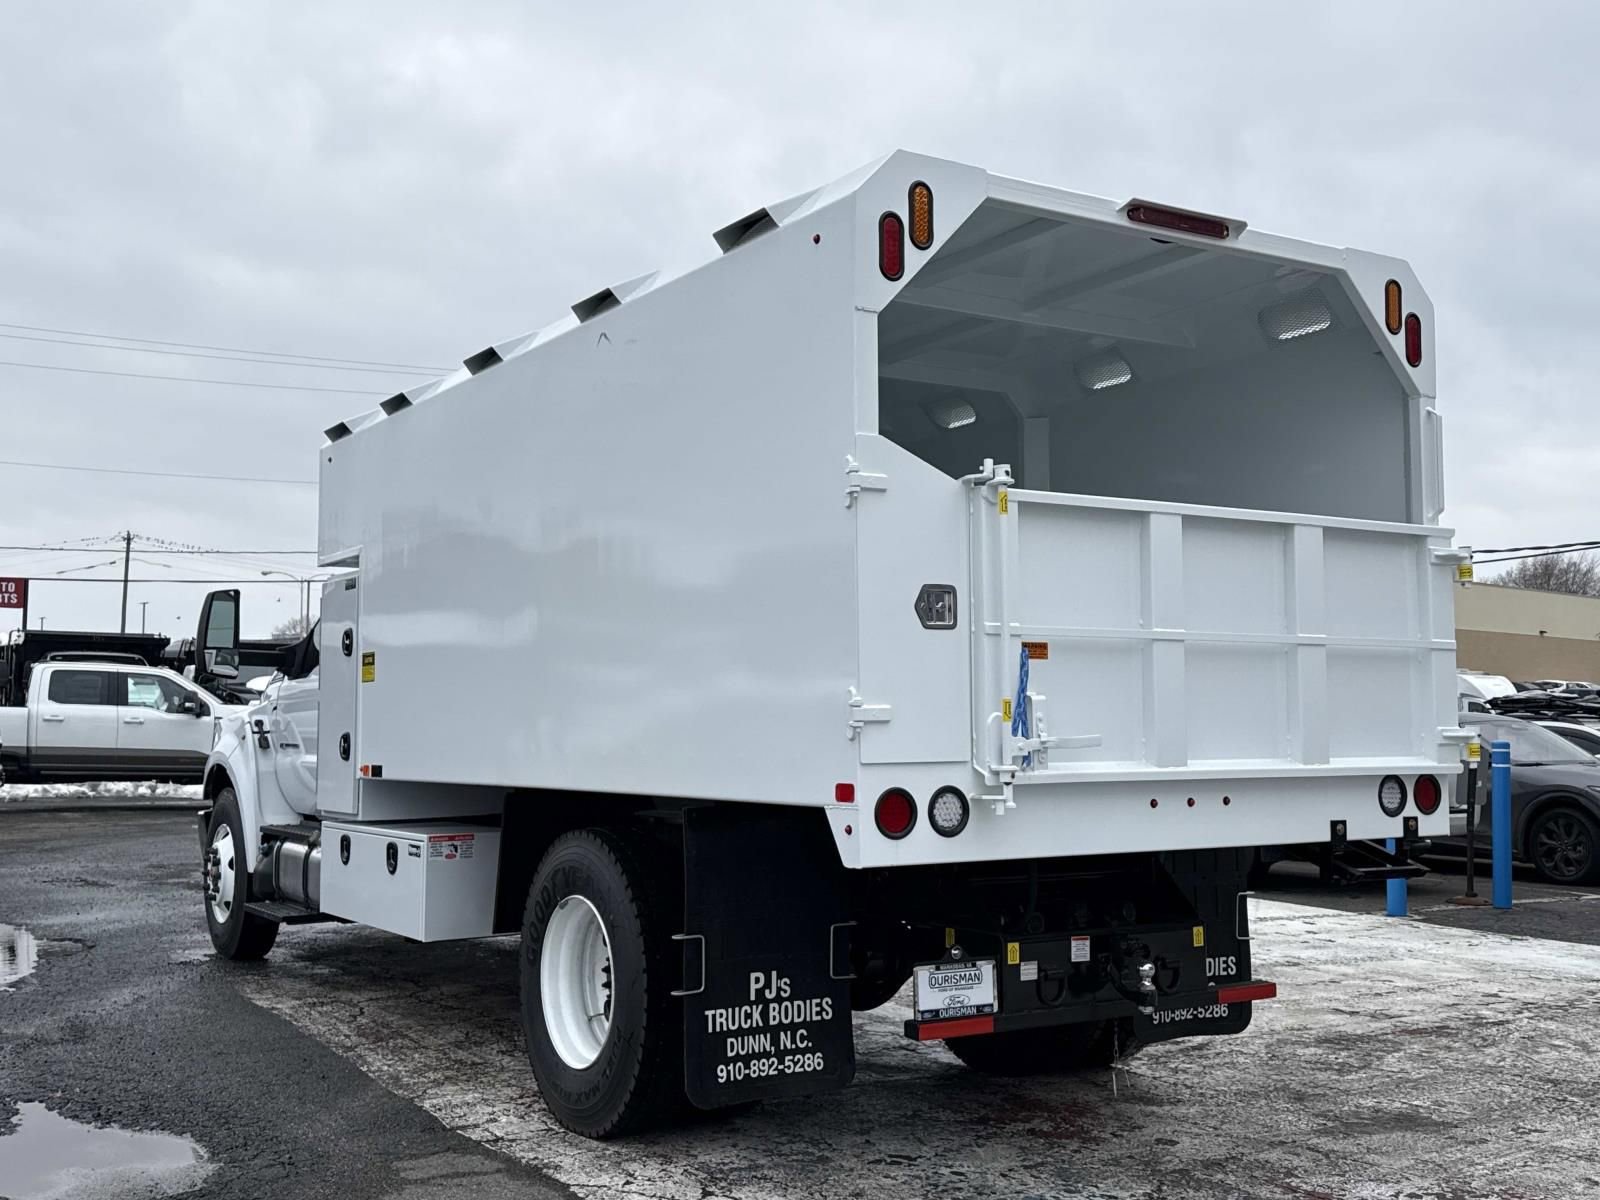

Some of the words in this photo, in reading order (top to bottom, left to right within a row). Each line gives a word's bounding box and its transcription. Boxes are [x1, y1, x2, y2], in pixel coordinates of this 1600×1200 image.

[0, 582, 16, 593] TO
[0, 593, 18, 604] TS
[749, 970, 791, 1001] PJ's
[930, 972, 981, 987] OURISMAN
[704, 1004, 763, 1033] TRUCK
[769, 997, 833, 1026] BODIES
[939, 1006, 977, 1018] OURISMAN
[726, 1033, 775, 1057] DUNN,
[780, 1029, 813, 1050] N.C.
[716, 1052, 824, 1083] 910-892-5286
